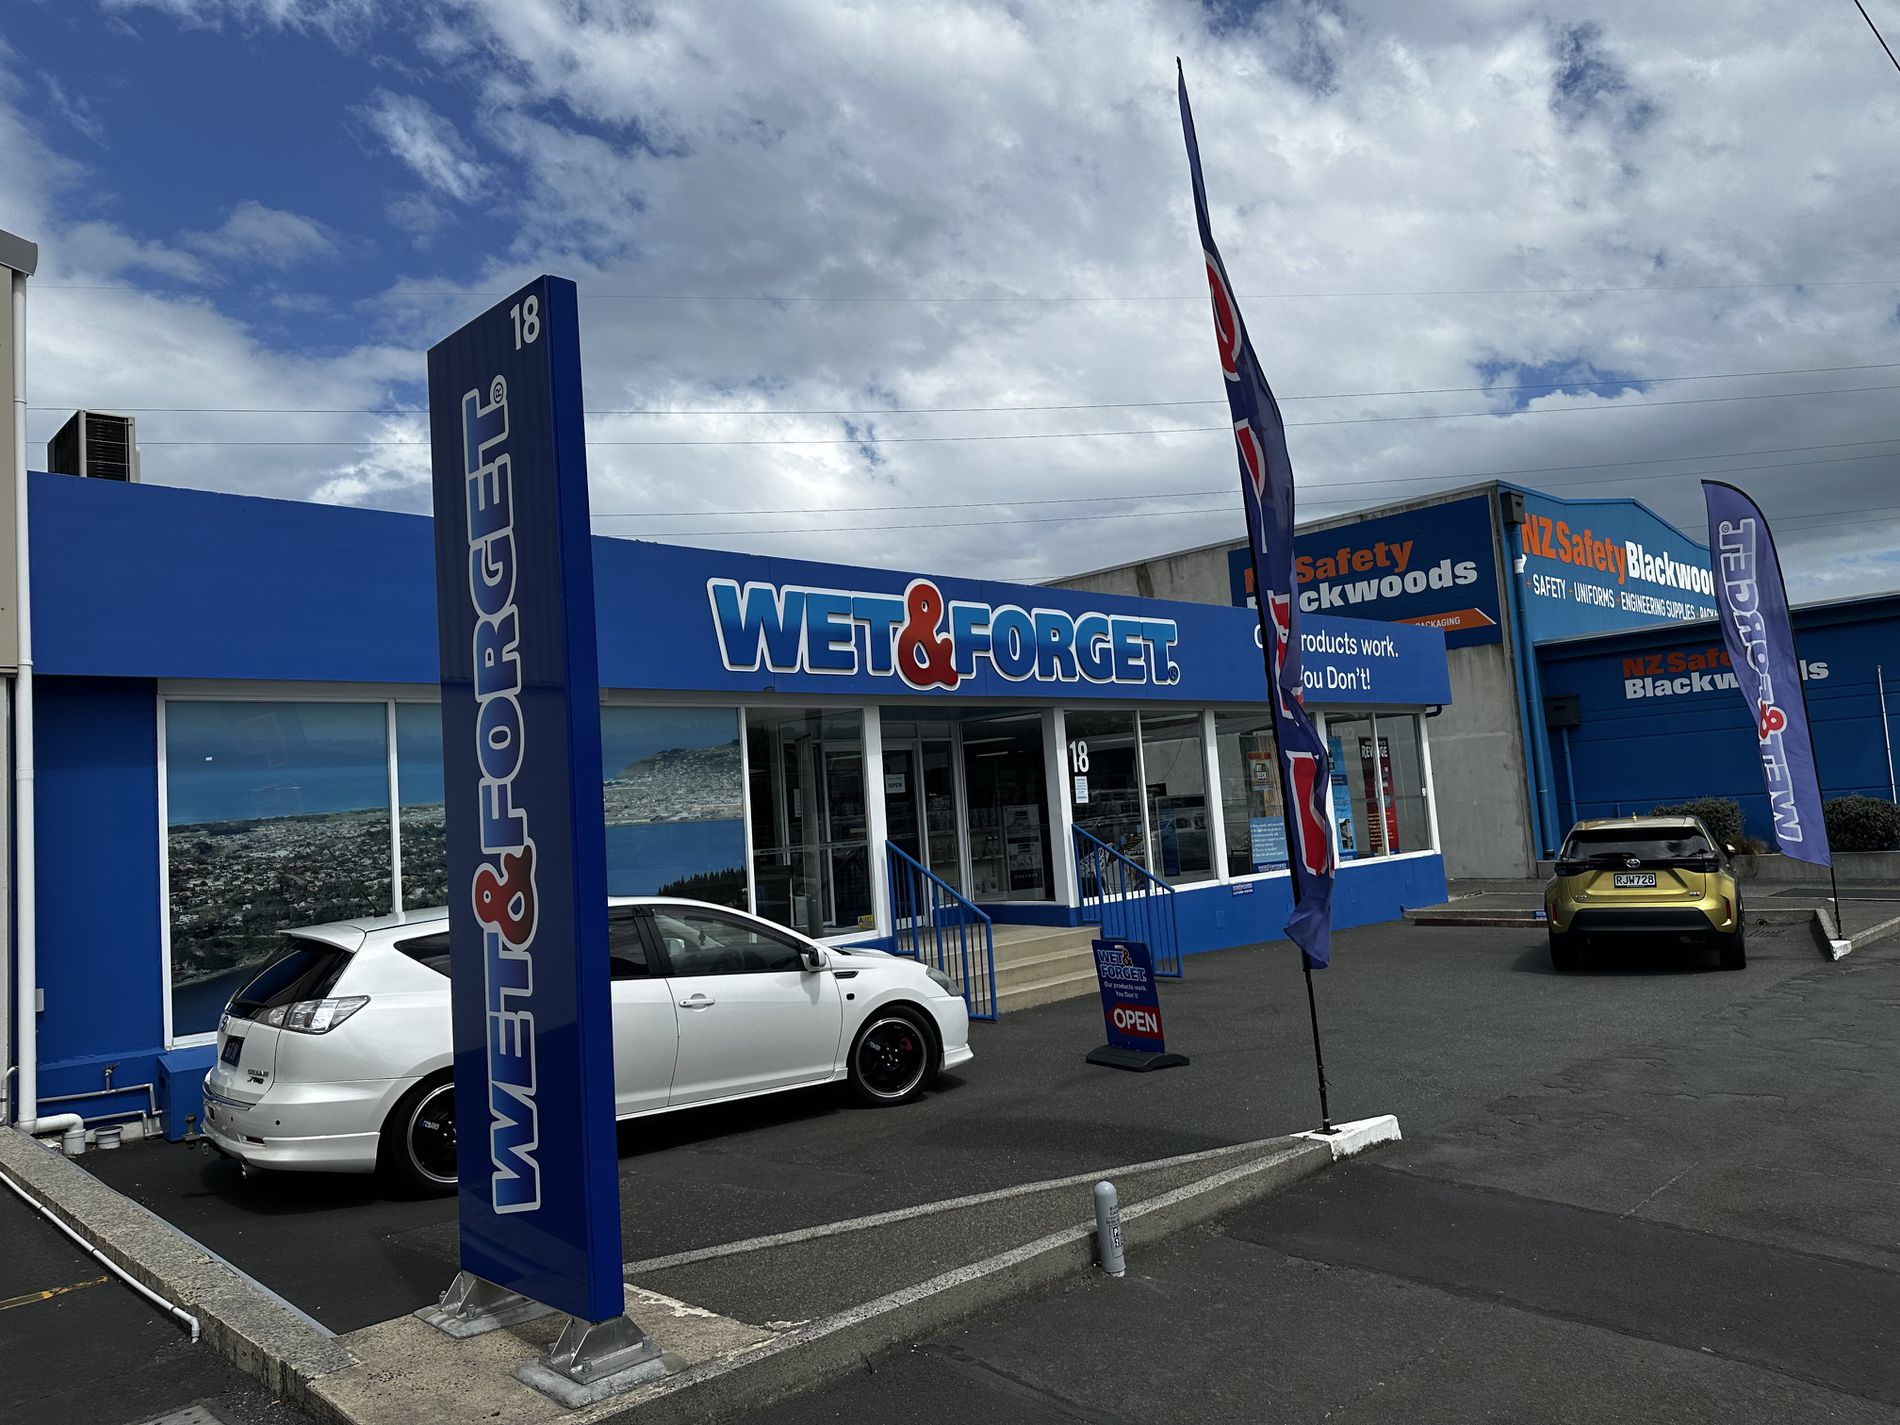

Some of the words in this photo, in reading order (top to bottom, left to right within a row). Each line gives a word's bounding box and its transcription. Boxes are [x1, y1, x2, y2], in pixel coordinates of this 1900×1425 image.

[510, 294, 541, 351] 18
[1295, 540, 1414, 584] Safety
[1521, 512, 1557, 559] NZ
[1556, 520, 1626, 585] Safety
[1533, 574, 1567, 600] SAFETY
[1574, 582, 1615, 609] UNIFORMS
[1620, 591, 1666, 617] ENGINEERING
[1666, 600, 1696, 621] SUPPLIES
[1301, 630, 1358, 655] roducts
[1361, 635, 1399, 658] work.
[1327, 666, 1371, 690] Don't!
[1622, 654, 1665, 678] NZ
[1667, 648, 1733, 673] Safe
[1069, 740, 1090, 773] 18
[1615, 874, 1655, 886] RJW728
[1113, 1008, 1158, 1033] OPEN
